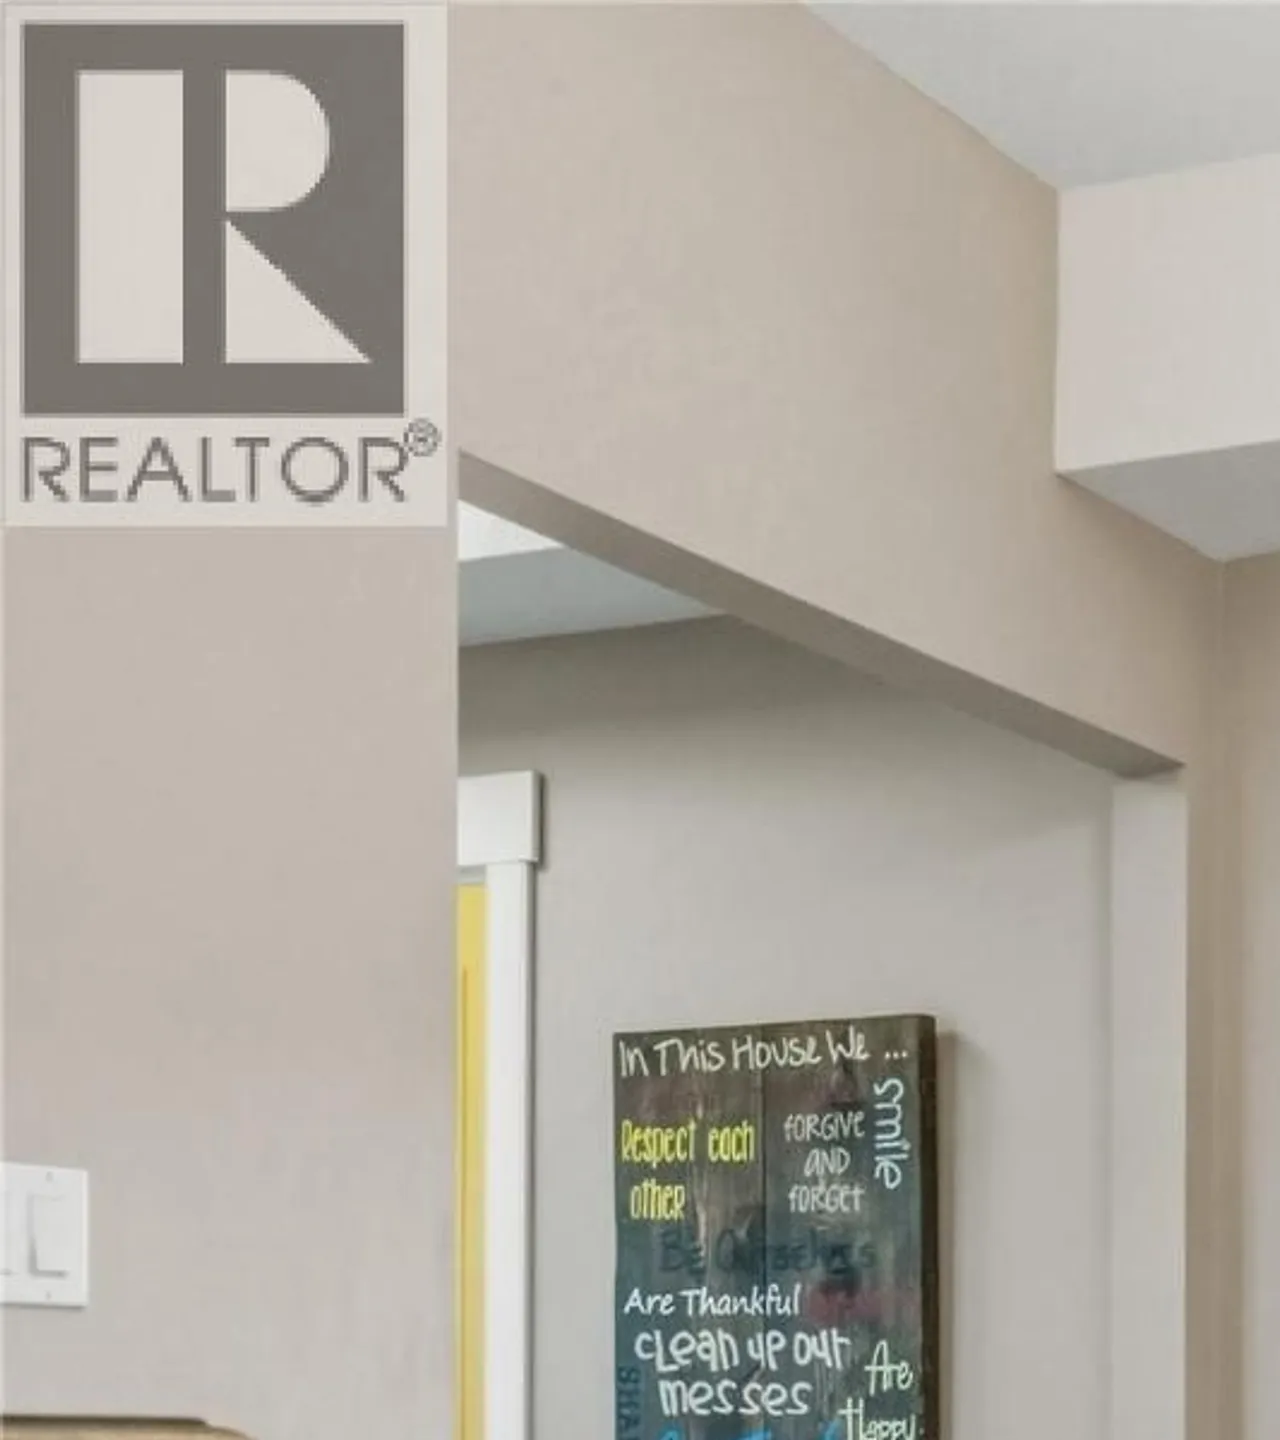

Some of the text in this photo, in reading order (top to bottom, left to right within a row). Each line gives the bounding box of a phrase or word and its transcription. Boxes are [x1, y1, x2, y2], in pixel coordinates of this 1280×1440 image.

[619, 1040, 649, 1077] In
[653, 1038, 726, 1076] This
[731, 1035, 822, 1071] House
[825, 1025, 871, 1062] We
[621, 1118, 756, 1169] Respect each
[623, 1288, 676, 1316] Are
[677, 1283, 802, 1317] Thankful
[747, 1330, 786, 1372] up
[793, 1327, 852, 1371] our
[863, 1340, 914, 1397] Are
[658, 1379, 814, 1417] messes
